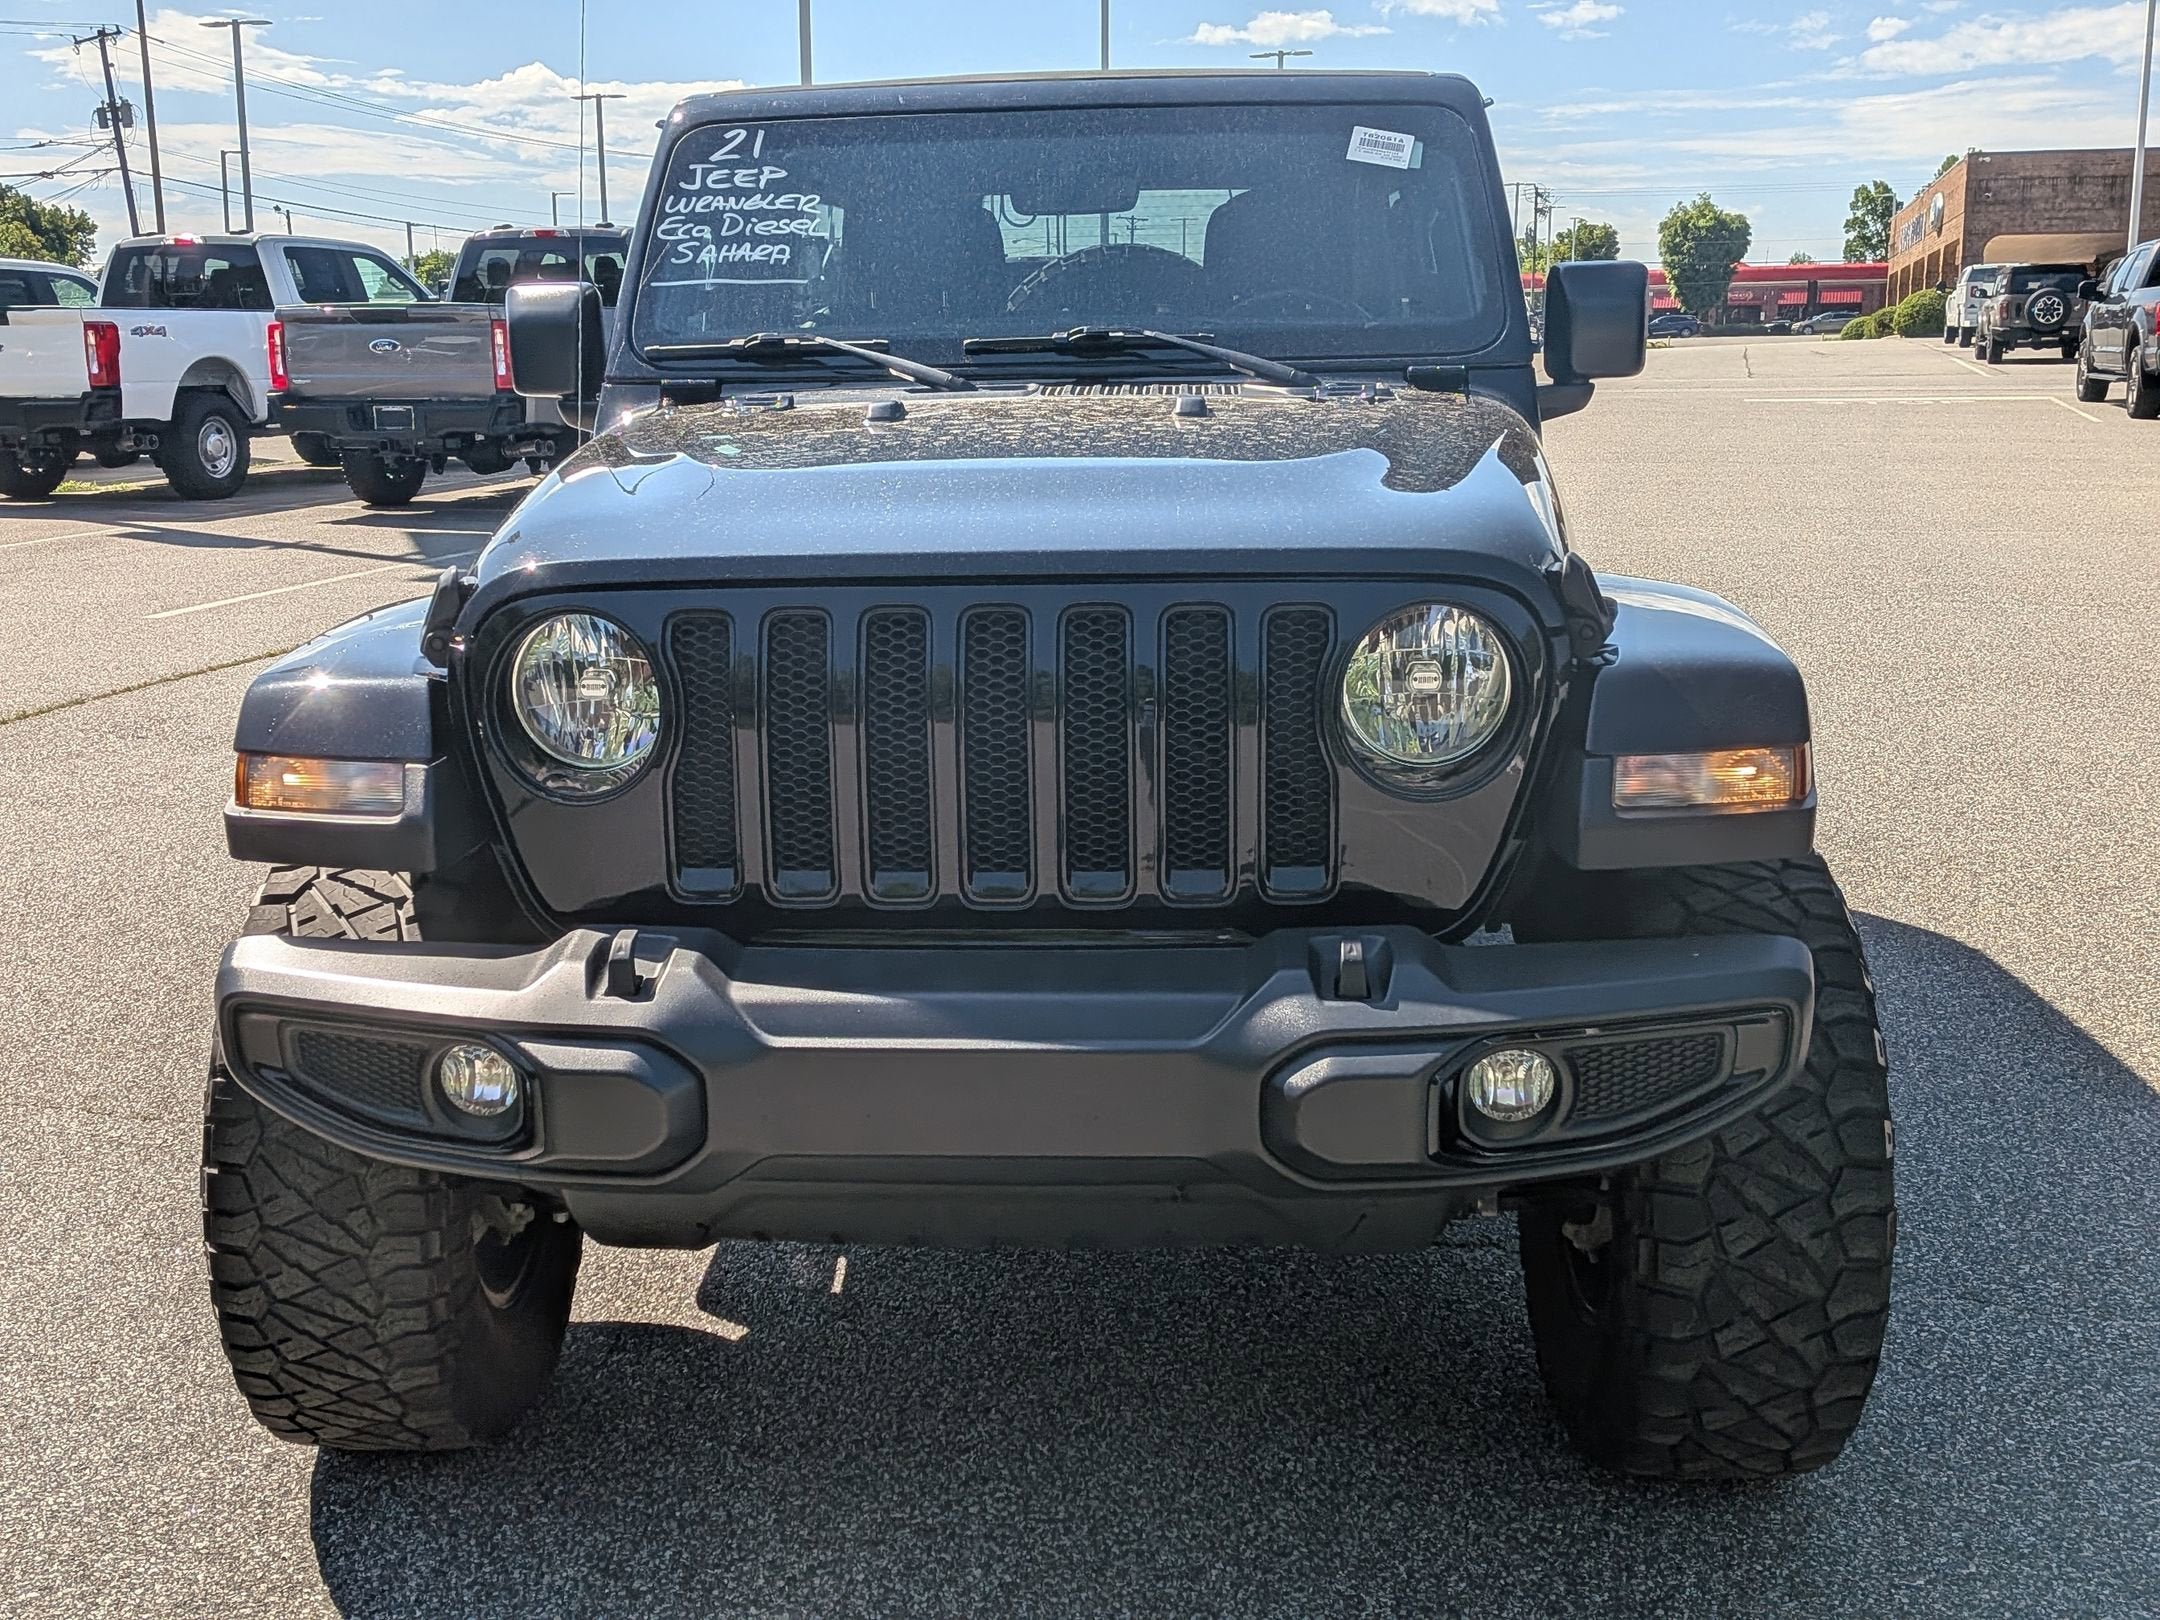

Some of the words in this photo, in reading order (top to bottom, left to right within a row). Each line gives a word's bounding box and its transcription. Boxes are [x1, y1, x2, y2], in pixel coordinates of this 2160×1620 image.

[709, 129, 765, 162] 21
[679, 164, 788, 190] JEEP
[665, 193, 822, 214] WRANGLER
[656, 216, 712, 240] Eco
[670, 242, 791, 265] SAHARA
